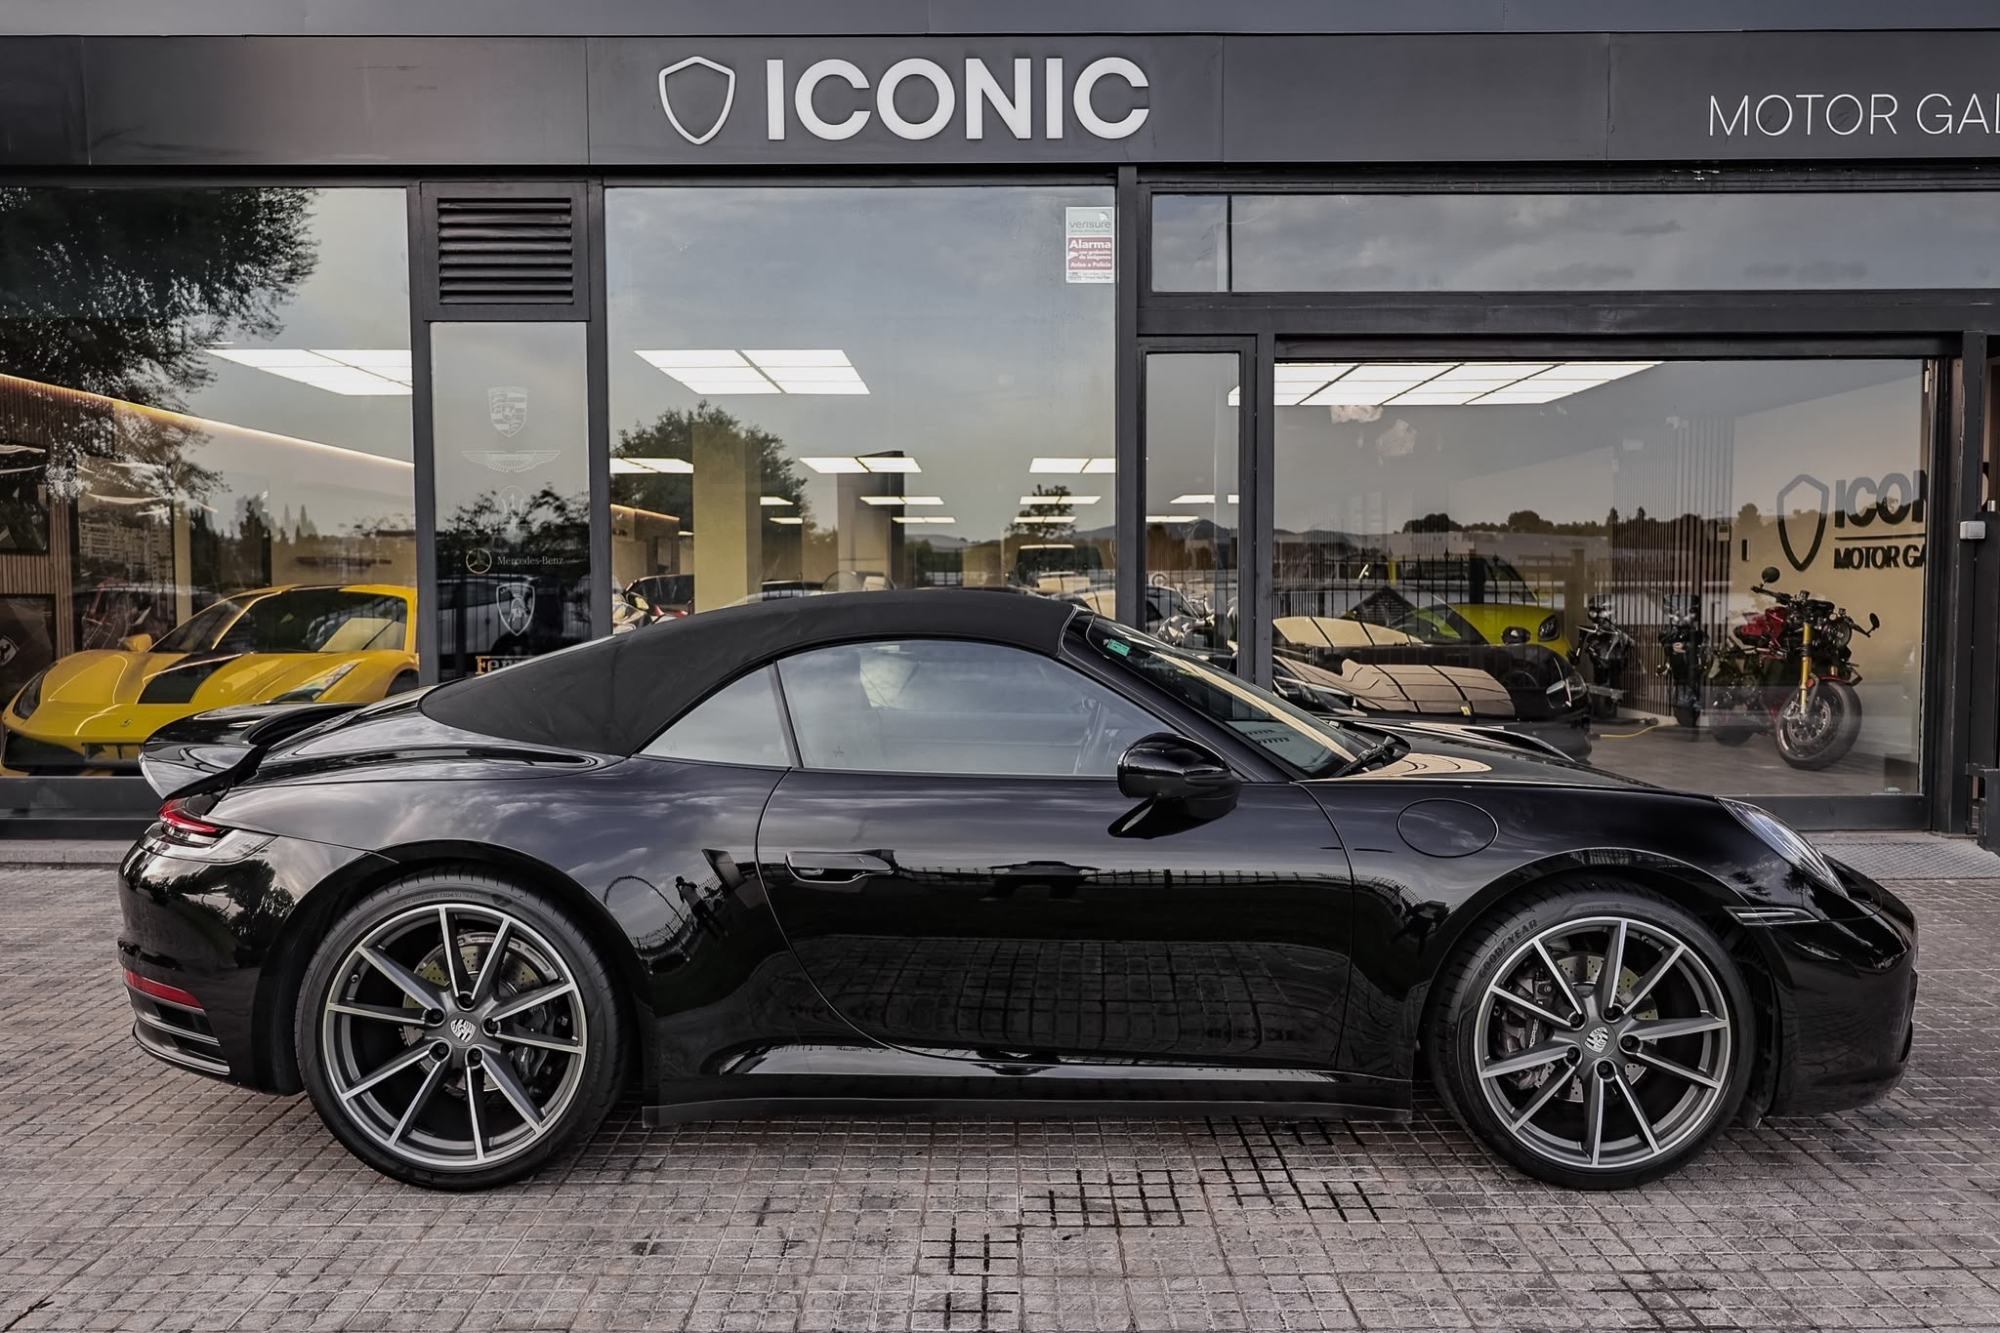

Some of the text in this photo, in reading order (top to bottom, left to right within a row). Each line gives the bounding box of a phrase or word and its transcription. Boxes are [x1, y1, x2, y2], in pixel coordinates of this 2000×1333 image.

[766, 56, 1150, 141] ICONIC
[1709, 93, 1898, 136] MOTOR
[1069, 220, 1111, 229] verisure
[1069, 238, 1111, 249] Alarma
[497, 556, 564, 566] Mercedes-Benz
[1834, 545, 1900, 570] MOTOR
[474, 655, 526, 675] Fer
